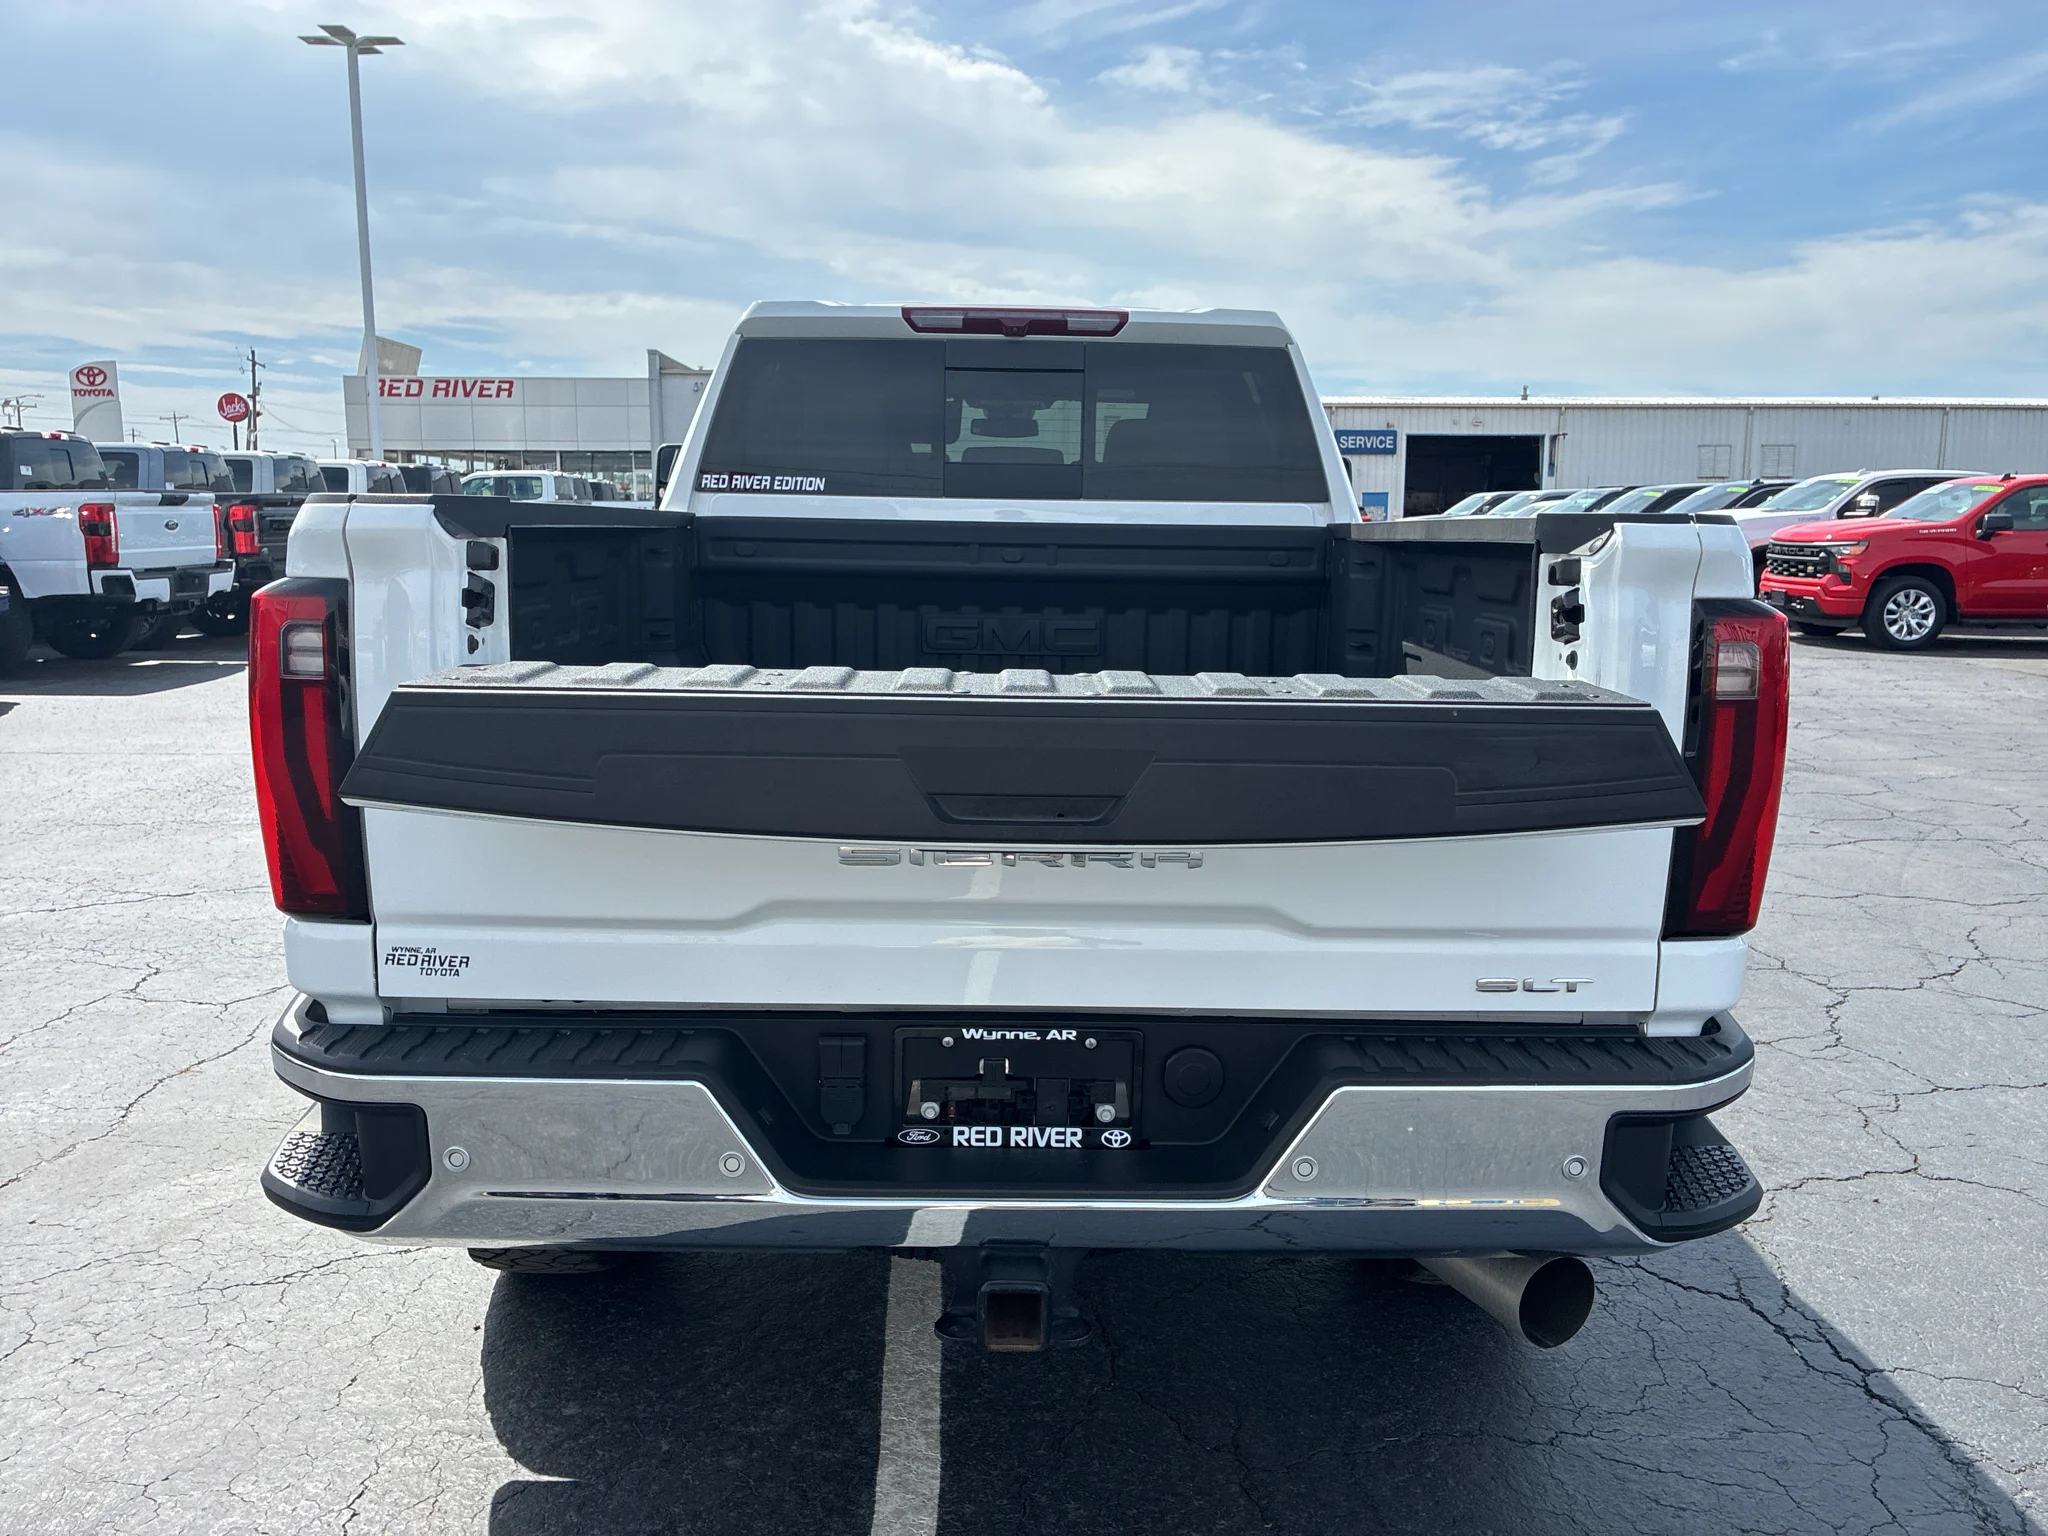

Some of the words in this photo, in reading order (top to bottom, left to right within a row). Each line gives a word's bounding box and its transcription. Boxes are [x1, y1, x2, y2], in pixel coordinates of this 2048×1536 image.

[72, 388, 115, 397] TOYOTA
[432, 379, 514, 398] RIVER
[219, 396, 246, 417] Jack's
[1339, 435, 1394, 449] SERVICE
[701, 474, 729, 488] RED
[731, 475, 771, 490] RIVER
[773, 476, 826, 491] EDITION
[926, 618, 1098, 653] GMC
[838, 846, 1203, 869] SIERRA
[391, 946, 423, 954] WYNNE,
[384, 953, 418, 966] RED
[420, 954, 470, 968] RIVER
[419, 967, 460, 977] TOYOTA
[1476, 977, 1594, 993] SLT
[962, 1028, 1041, 1041] Wynne,
[1045, 1029, 1077, 1041] AR
[906, 1131, 932, 1141] Ford
[952, 1126, 1002, 1147] RED
[1010, 1126, 1083, 1148] RIVER
